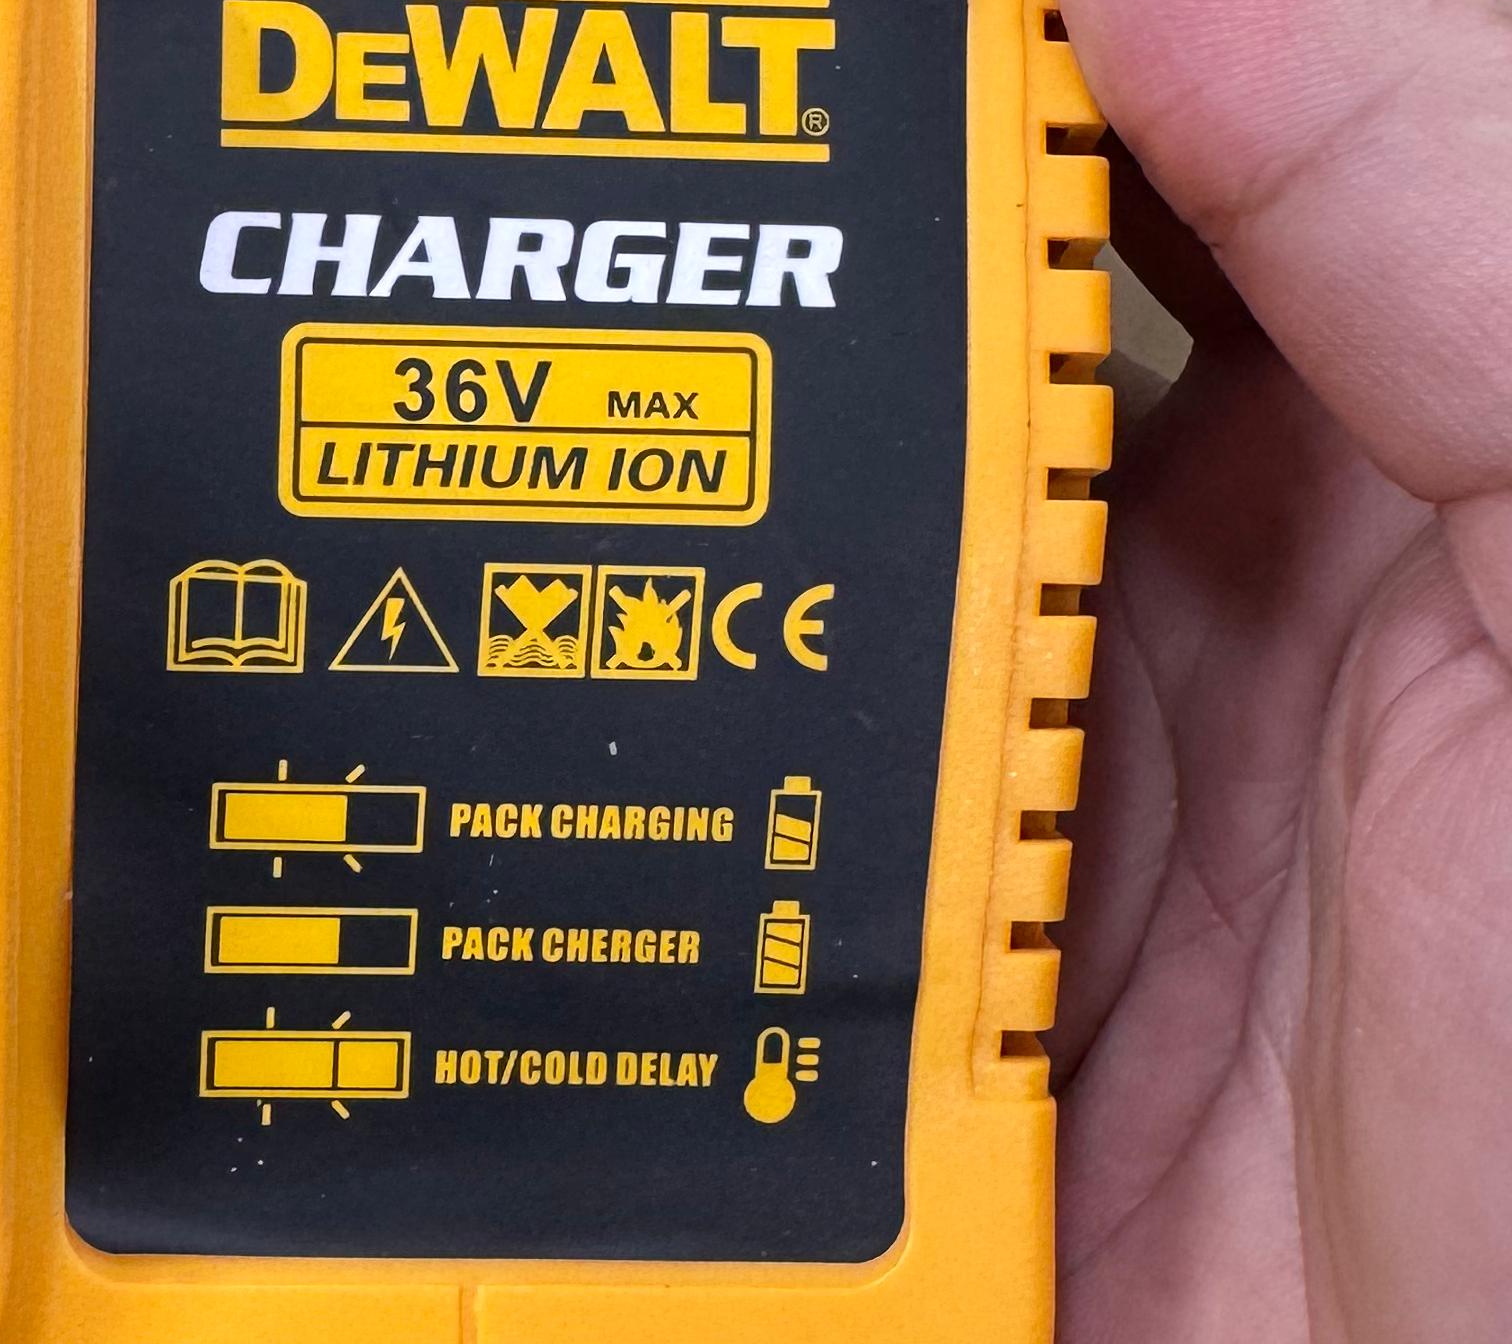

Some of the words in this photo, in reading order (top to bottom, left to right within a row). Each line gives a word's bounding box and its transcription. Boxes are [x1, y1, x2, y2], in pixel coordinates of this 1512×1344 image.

[200, 211, 843, 307] CHARGER
[394, 358, 551, 422] 36V
[609, 391, 697, 419] MAX
[318, 443, 588, 490] LITHIUM
[609, 448, 726, 492] ION
[450, 803, 543, 839] PACK
[551, 804, 734, 842] CHARGING
[442, 927, 534, 962] PACK
[542, 928, 700, 963] CHERGER
[435, 1050, 607, 1086] HOT/COLD
[616, 1052, 718, 1087] DELAY
